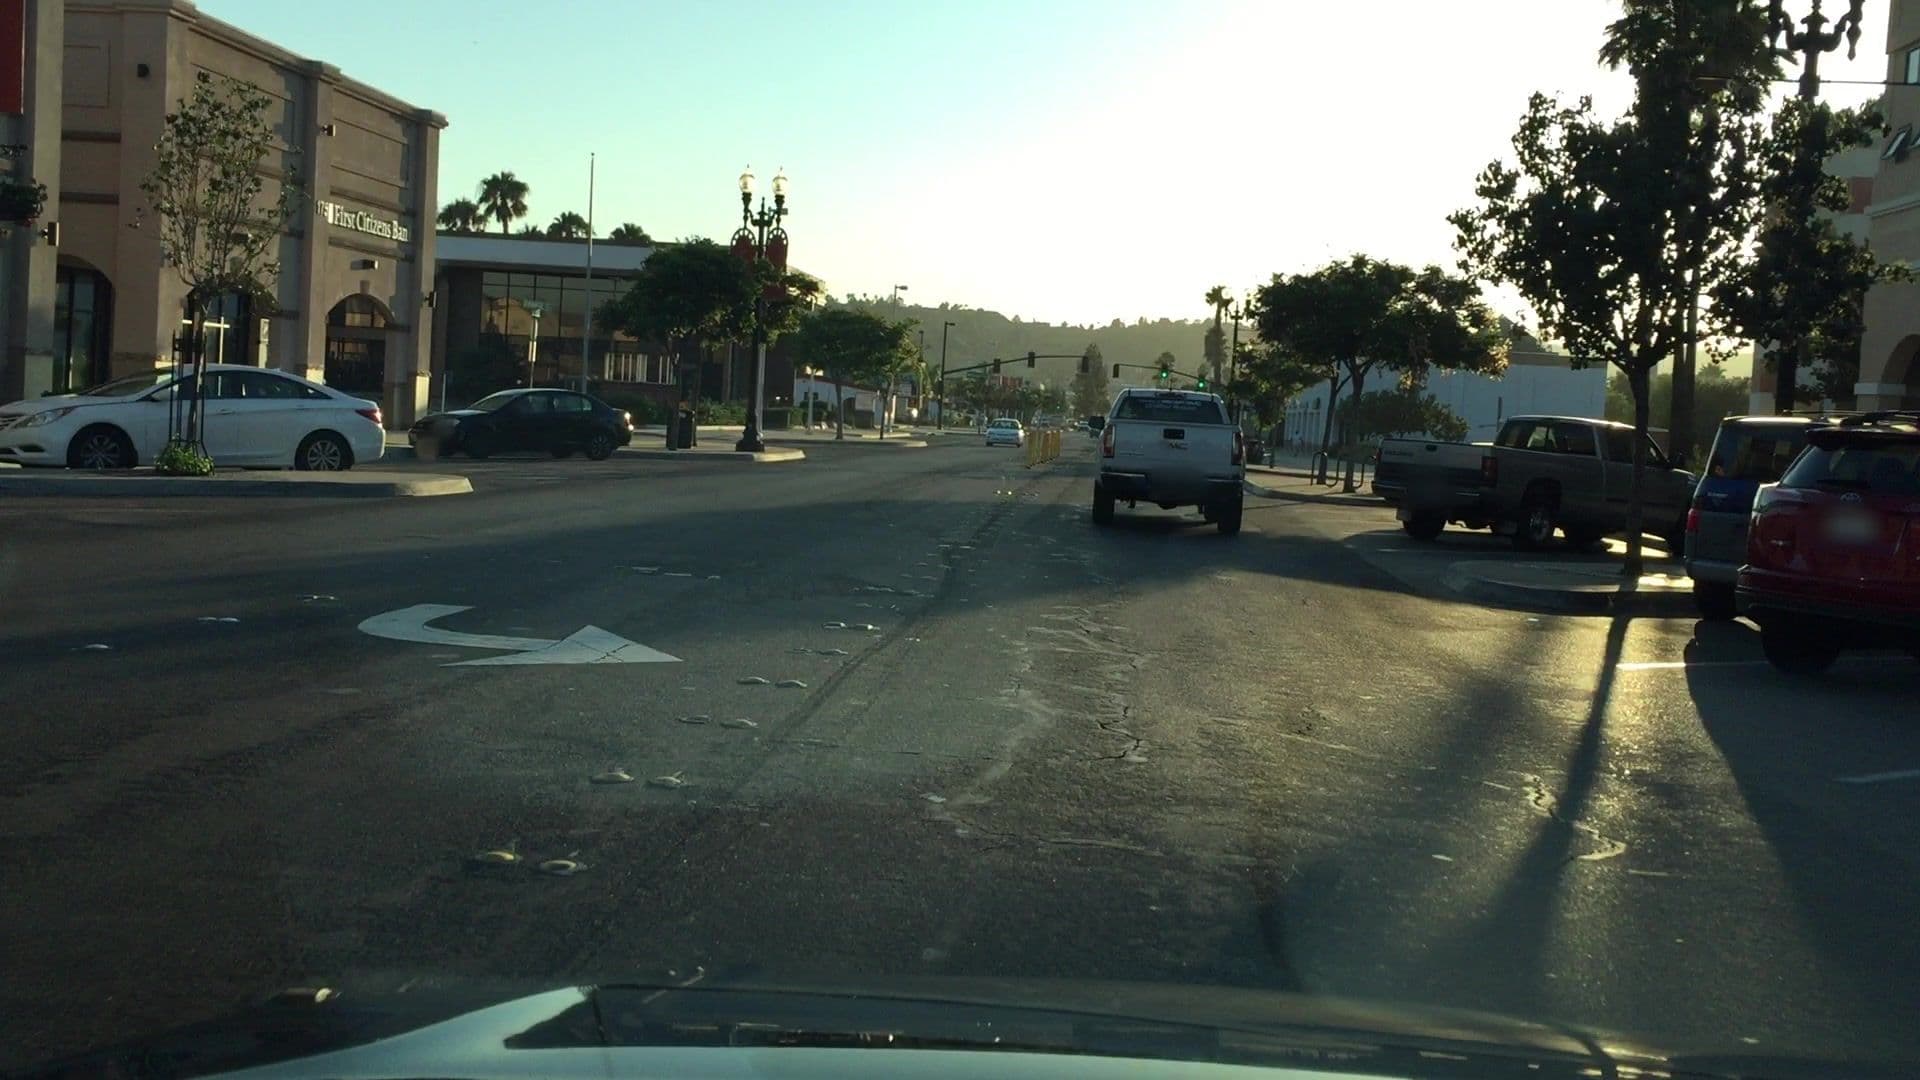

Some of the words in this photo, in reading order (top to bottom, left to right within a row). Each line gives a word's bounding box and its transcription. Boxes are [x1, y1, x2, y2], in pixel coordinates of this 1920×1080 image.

[334, 204, 356, 229] First
[356, 211, 392, 238] Citizens
[392, 220, 409, 242] Ban
